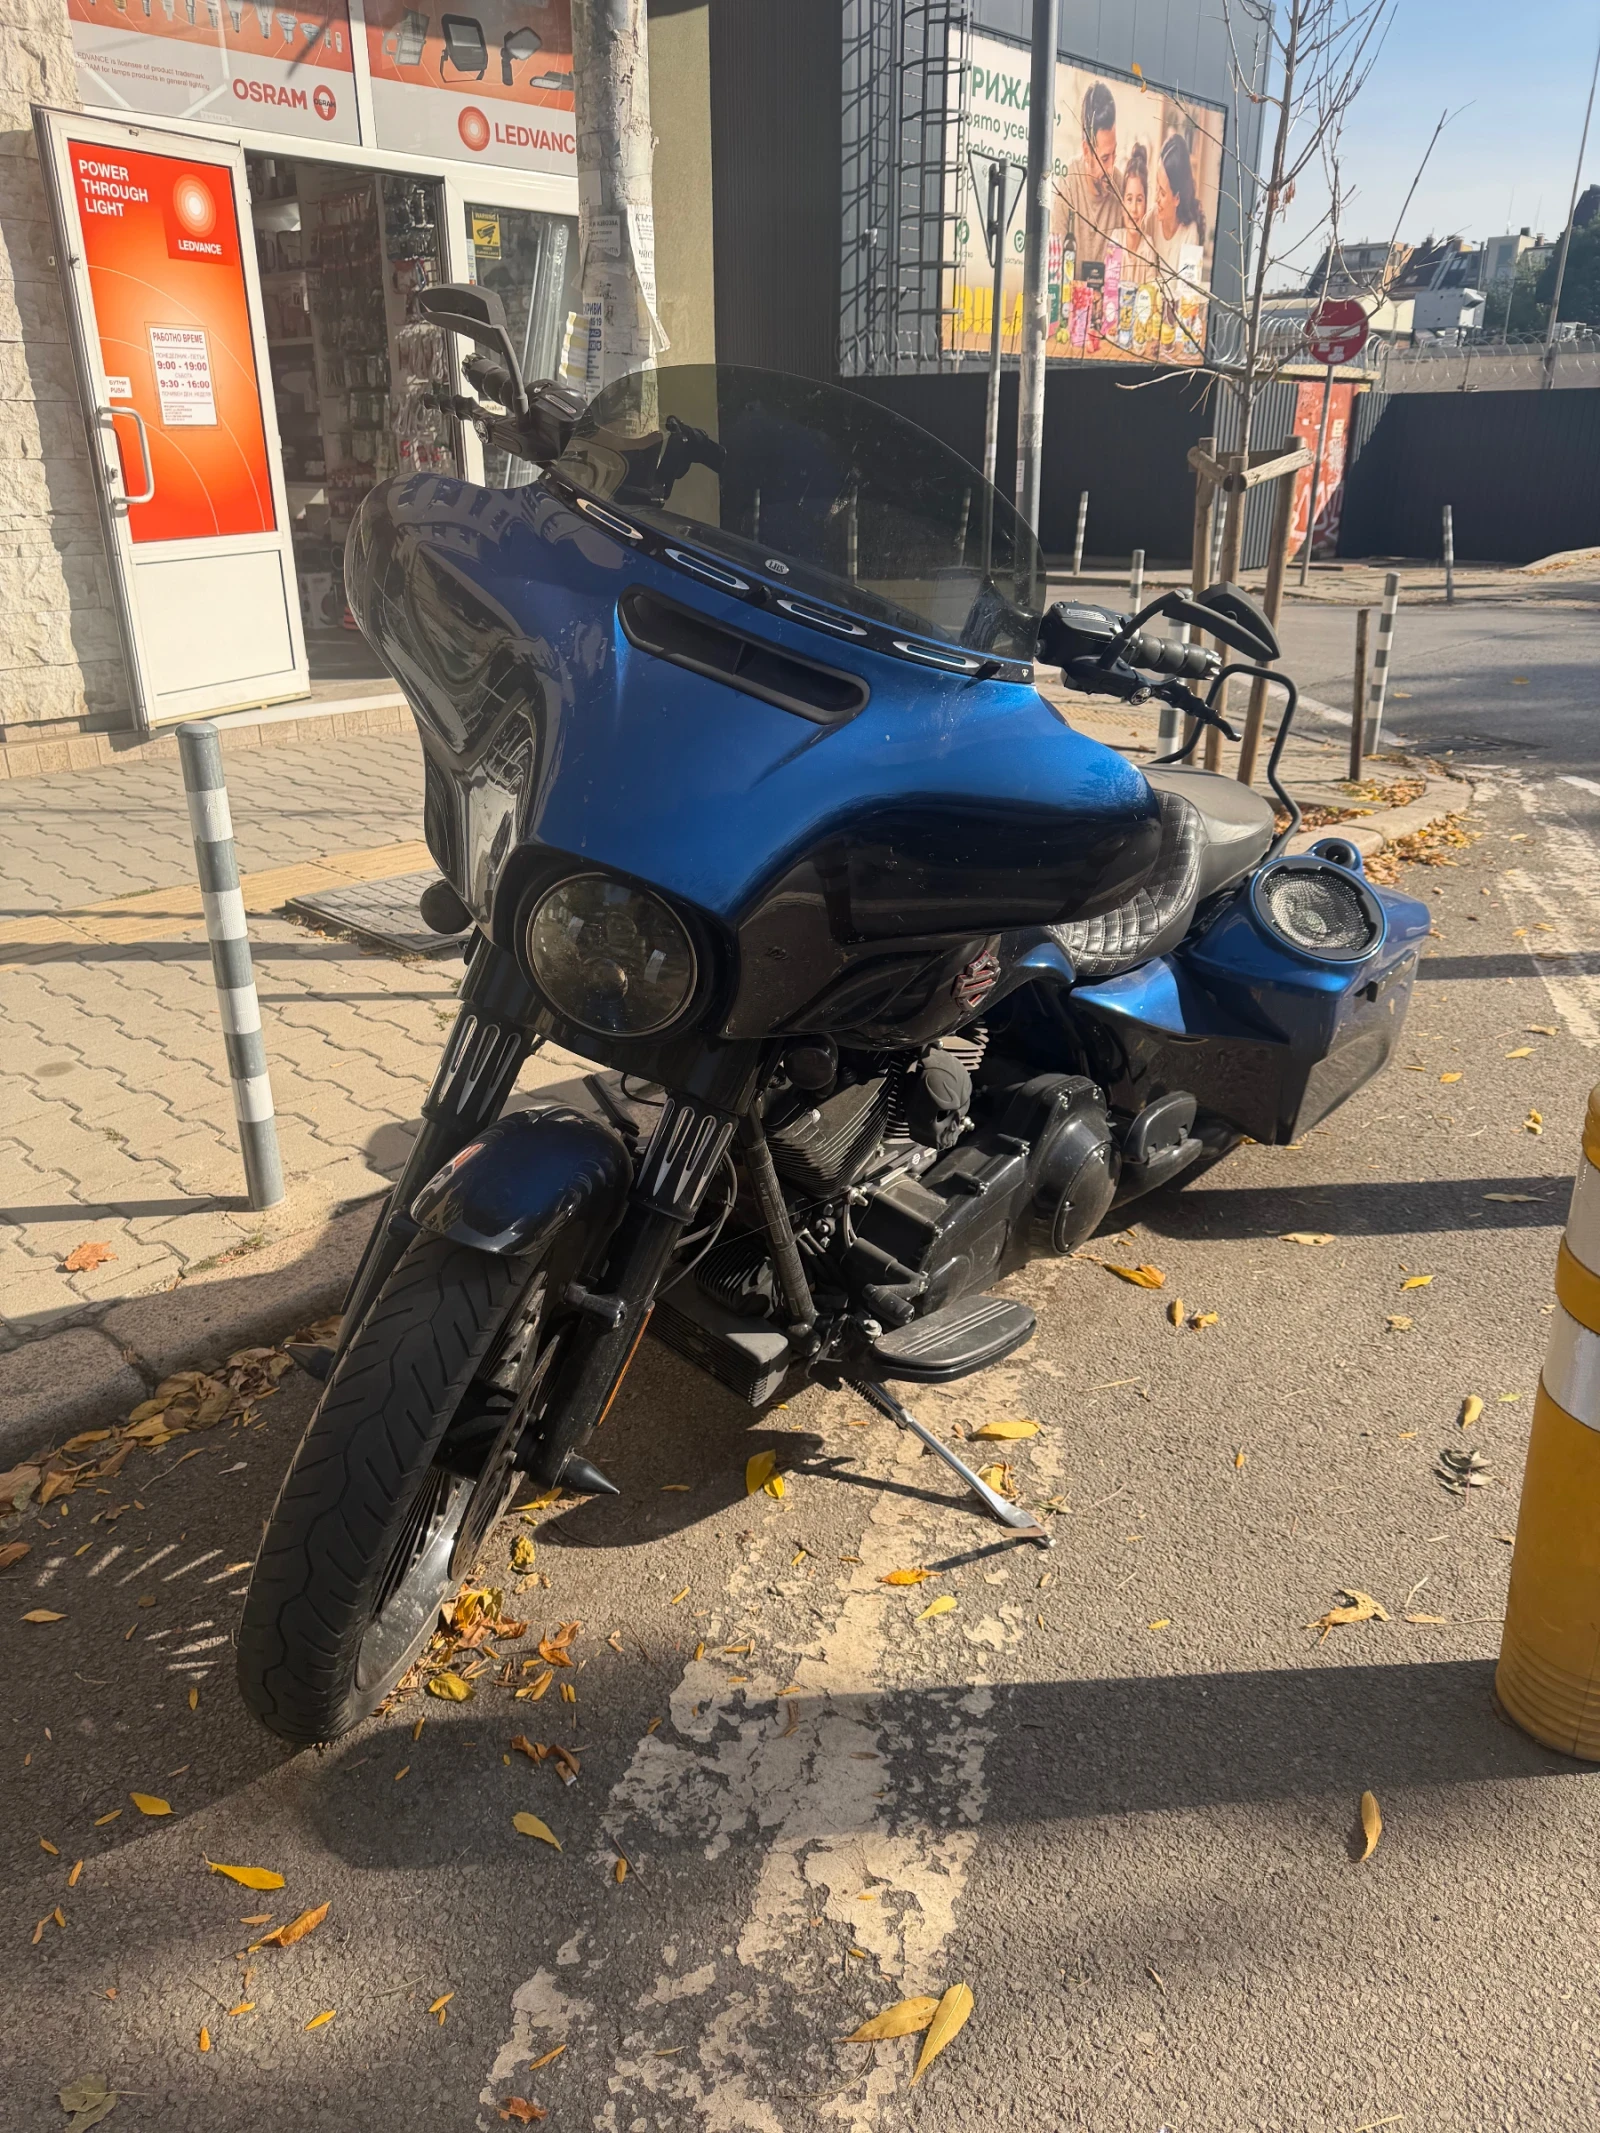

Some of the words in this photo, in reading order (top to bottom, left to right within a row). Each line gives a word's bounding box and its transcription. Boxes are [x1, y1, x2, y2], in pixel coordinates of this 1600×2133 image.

[76, 51, 109, 64] EDVANCE
[110, 57, 116, 65] is
[117, 58, 142, 69] licensee
[151, 65, 174, 75] product
[175, 69, 204, 80] trademark
[101, 64, 110, 73] for
[131, 71, 158, 82] products
[166, 77, 188, 86] general
[232, 78, 308, 110] OSRAM
[313, 97, 337, 108] OSRAM
[961, 112, 1000, 133] оято
[494, 122, 576, 154] LEDVANC
[78, 159, 129, 181] POWER
[81, 178, 149, 203] THROUGH
[84, 197, 124, 217] LIGHT
[178, 239, 222, 255] LEDVANCE
[153, 331, 182, 343] РАБОТНО
[183, 333, 204, 344] ВРЕМЕ
[157, 360, 176, 370] 9:00
[184, 361, 207, 371] 19:00
[160, 380, 179, 388] 9:30
[187, 380, 210, 389] 16:00
